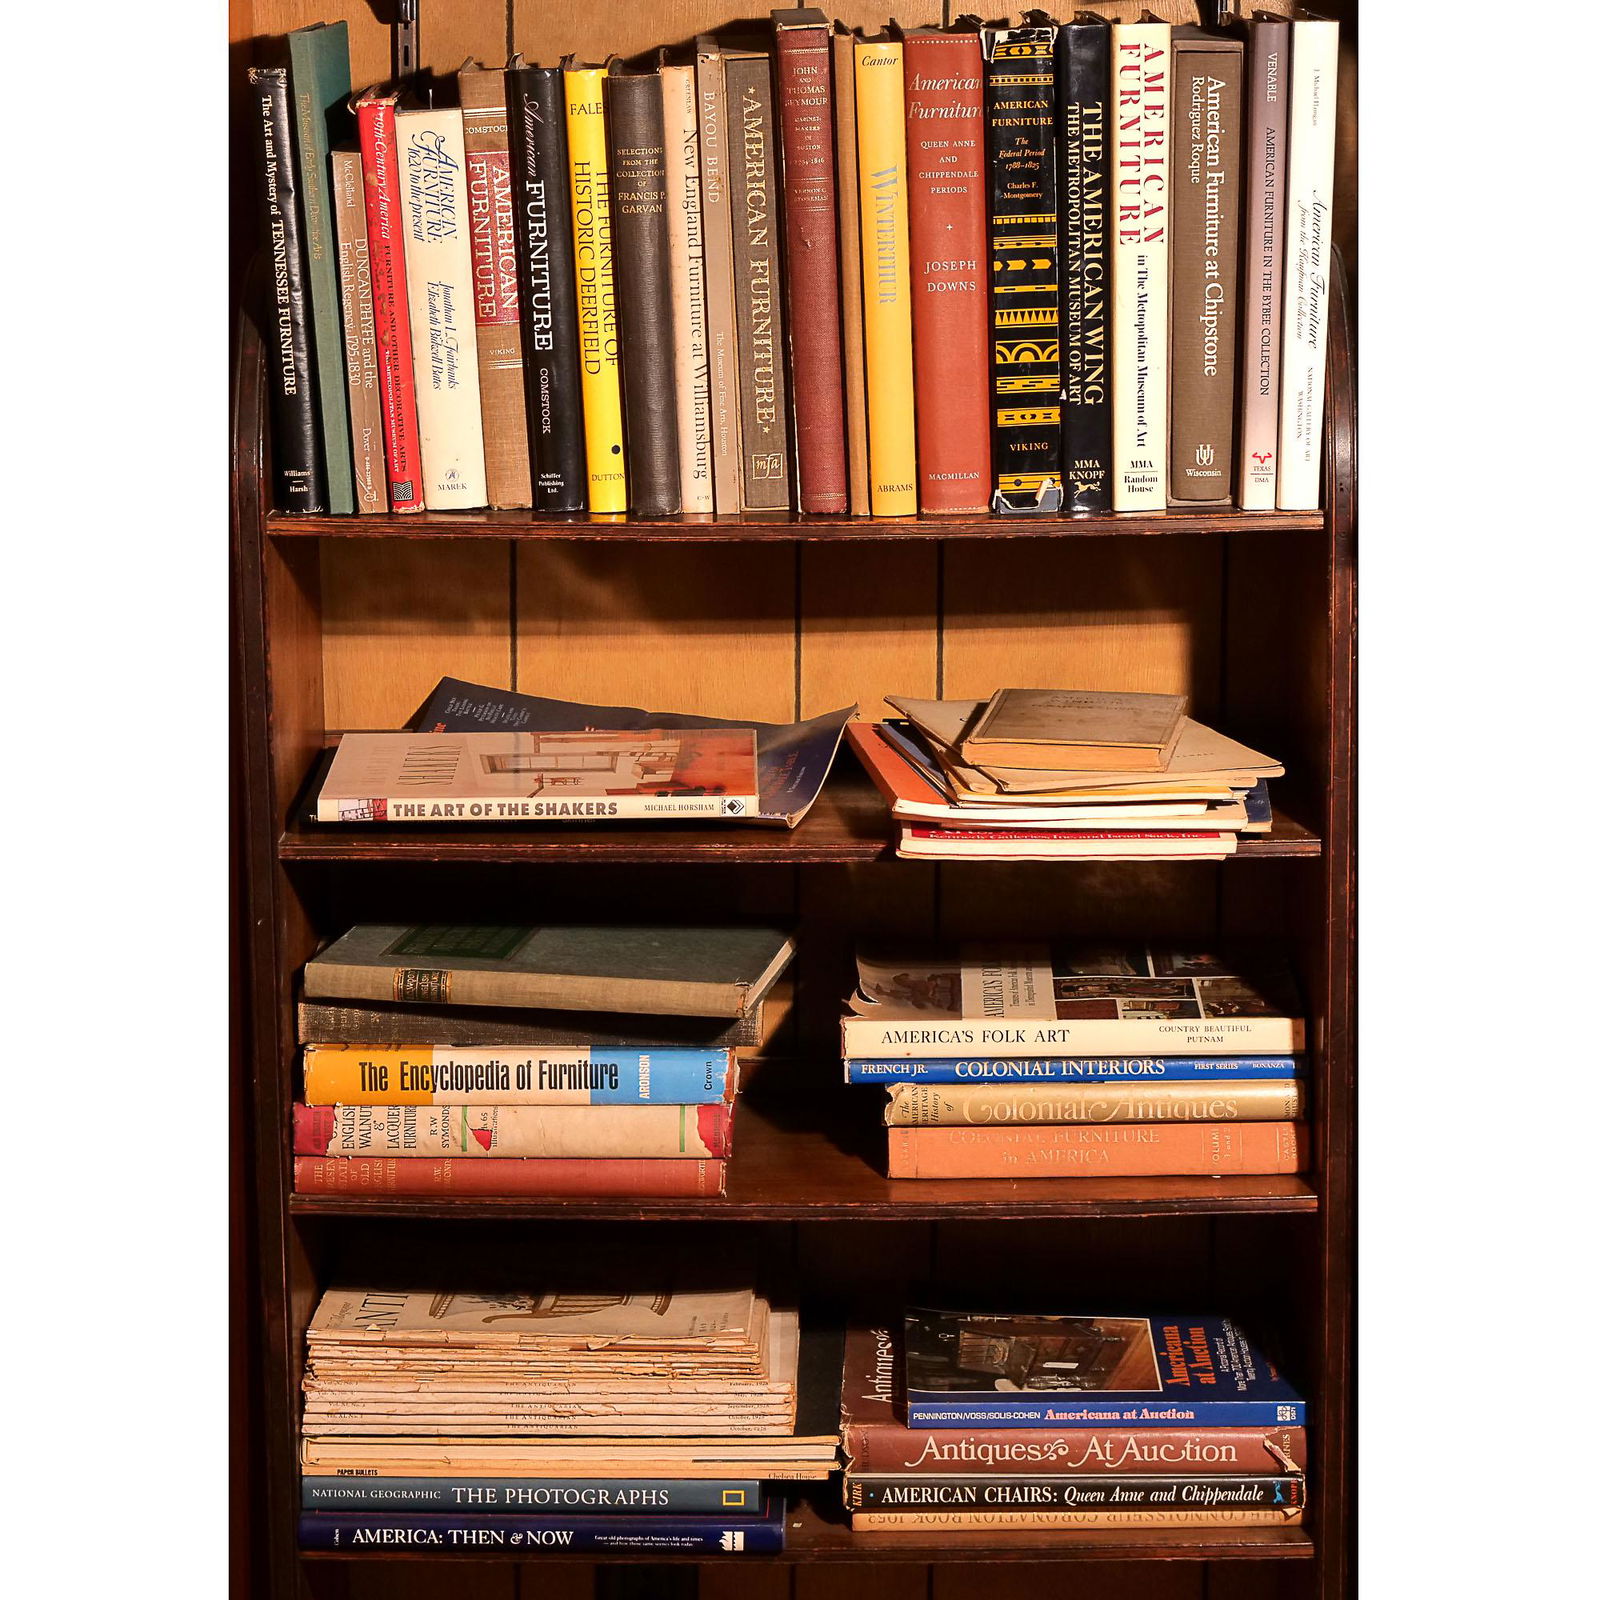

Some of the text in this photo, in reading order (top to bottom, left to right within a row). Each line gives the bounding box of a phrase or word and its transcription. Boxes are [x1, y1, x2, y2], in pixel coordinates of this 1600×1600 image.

[861, 56, 899, 66] Cantor
[793, 66, 818, 76] JOHN
[1266, 52, 1278, 102] VENABLE
[786, 85, 826, 95] THOMAS
[993, 100, 1049, 110] AMERICAN
[991, 117, 1054, 127] FURNITURE
[1188, 76, 1206, 184] Rodriguez Roque
[704, 92, 720, 204] BAYOU BEND
[920, 140, 976, 150] QUEEN ANNE
[1014, 137, 1029, 146] The
[1119, 43, 1141, 245] FURNITURE
[1143, 43, 1165, 244] AMERICAN
[939, 155, 958, 163] AND
[1024, 148, 1046, 157] Period
[919, 170, 980, 179] CHIPPENDALE
[930, 186, 968, 194] PERIODS
[1006, 182, 1031, 190] Charles
[618, 191, 658, 201] FRANCIS
[379, 188, 391, 240] America
[621, 204, 662, 214] GARVAN
[408, 201, 424, 242] present
[523, 93, 554, 351] American FURNITURE
[1199, 76, 1226, 377] American Furniture at Chipstone
[469, 160, 497, 318] FURNITURE
[492, 166, 520, 309] AMERICAN
[871, 164, 899, 304] WINTERTHUR
[261, 95, 297, 396] The Art and Mystery of TENNESSEE FURNITURE
[1067, 101, 1082, 406] THE METROPOLITAN MUSEUM OF ART
[1082, 101, 1104, 406] THE AMERICAN WING
[575, 162, 601, 375] HISTORIC DEERFIELD
[743, 96, 776, 423] AMERICAN FURNITURE
[924, 259, 976, 275] JOSEPH
[1260, 127, 1276, 396] AMERICAN FURNITURE IN THE BYBEE COLLECTION
[1308, 190, 1328, 349] American Furniture
[927, 281, 976, 292] DOWNS
[354, 239, 377, 367] DUNCAN PHYFE and
[682, 129, 713, 480] New England Furniture Williamsburg
[716, 332, 725, 346] The
[385, 245, 408, 473] FURNITURE AND OTHER DECORATIVE ARTS
[1134, 255, 1149, 447] in The Metropolitan Museum of Art
[540, 368, 551, 434] COMSTOCK
[362, 428, 373, 452] Dover
[1010, 442, 1049, 451] VIKING
[1074, 459, 1100, 469] MMA
[1130, 460, 1153, 468] MMA
[1185, 468, 1222, 477] Wisconsin
[929, 472, 980, 481] MACMILLAN
[1069, 470, 1106, 480] KNOPF
[1124, 474, 1158, 483] Random
[877, 484, 914, 493] ABRAMS
[1128, 485, 1154, 493] House
[393, 802, 618, 817] THE ART OF THE SHAKERS
[881, 1029, 1070, 1044] AMERICA'S FOLK ART
[1158, 1025, 1252, 1033] COUNTRY BEAUTIFUL
[861, 1064, 928, 1076] FRENCH JR.
[955, 1059, 1165, 1078] COLONIAL INTERIORS
[1194, 1062, 1238, 1070] FIRST SERIES
[359, 1060, 619, 1094] The Encyclopedia of Furniture
[639, 1054, 650, 1099] ARONSON
[704, 1061, 713, 1091] Crown
[931, 1093, 941, 1122] History
[963, 1098, 1238, 1125] Colonial Antiques
[441, 1104, 451, 1149] SYMONDS
[1053, 1129, 1160, 1143] FURNITURE
[1159, 1325, 1190, 1387] Americana
[1182, 1326, 1213, 1371] Auction
[913, 1412, 1041, 1420] PENNINGTON/VOSS/SOLIS-COHEN
[1044, 1408, 1195, 1420] Americana at Auction
[904, 1435, 1041, 1467] Antiques
[1067, 1435, 1114, 1467] At
[1104, 1435, 1238, 1467] Auction
[312, 1487, 669, 1506] NATIONAL GEOGRAPHIC THE PHOTOGRAPHS
[852, 1482, 862, 1507] KIRK
[882, 1485, 1264, 1506] AMERICAN CHAIRS: Queen Anne and Chippendale
[353, 1528, 576, 1545] AMERICA: THEN & NOW
